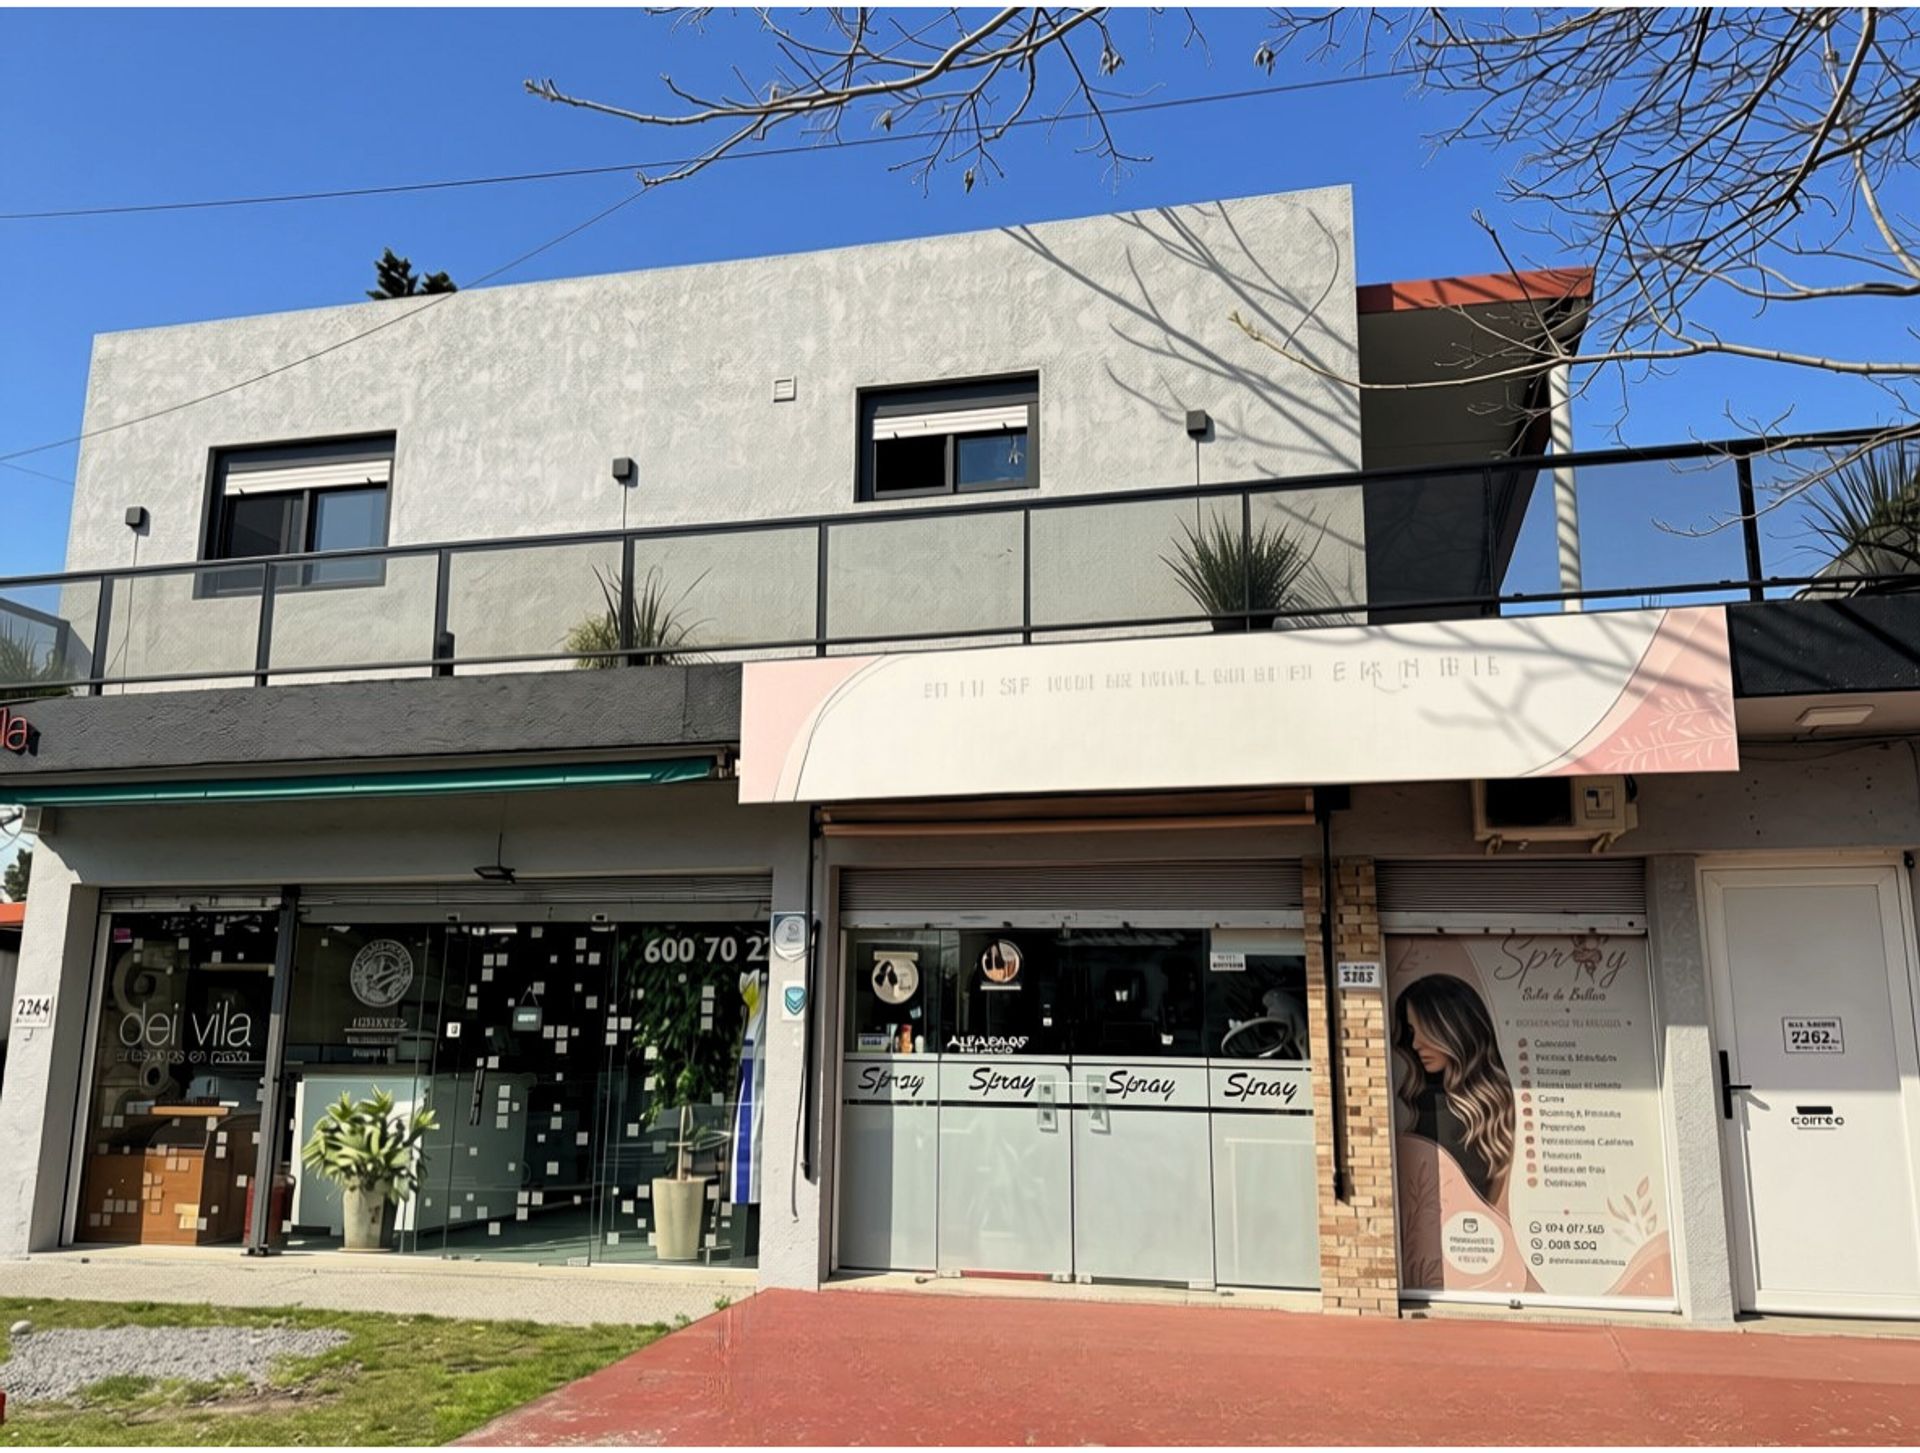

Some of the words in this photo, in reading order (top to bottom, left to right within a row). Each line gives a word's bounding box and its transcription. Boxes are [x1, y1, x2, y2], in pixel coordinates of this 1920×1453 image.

[644, 936, 695, 963] 600
[704, 936, 737, 962] 70
[192, 1000, 252, 1047] vila
[858, 1066, 925, 1097] Spray
[969, 1067, 1036, 1097] Spray
[1106, 1070, 1176, 1101] Spray
[1224, 1072, 1297, 1104] Spray
